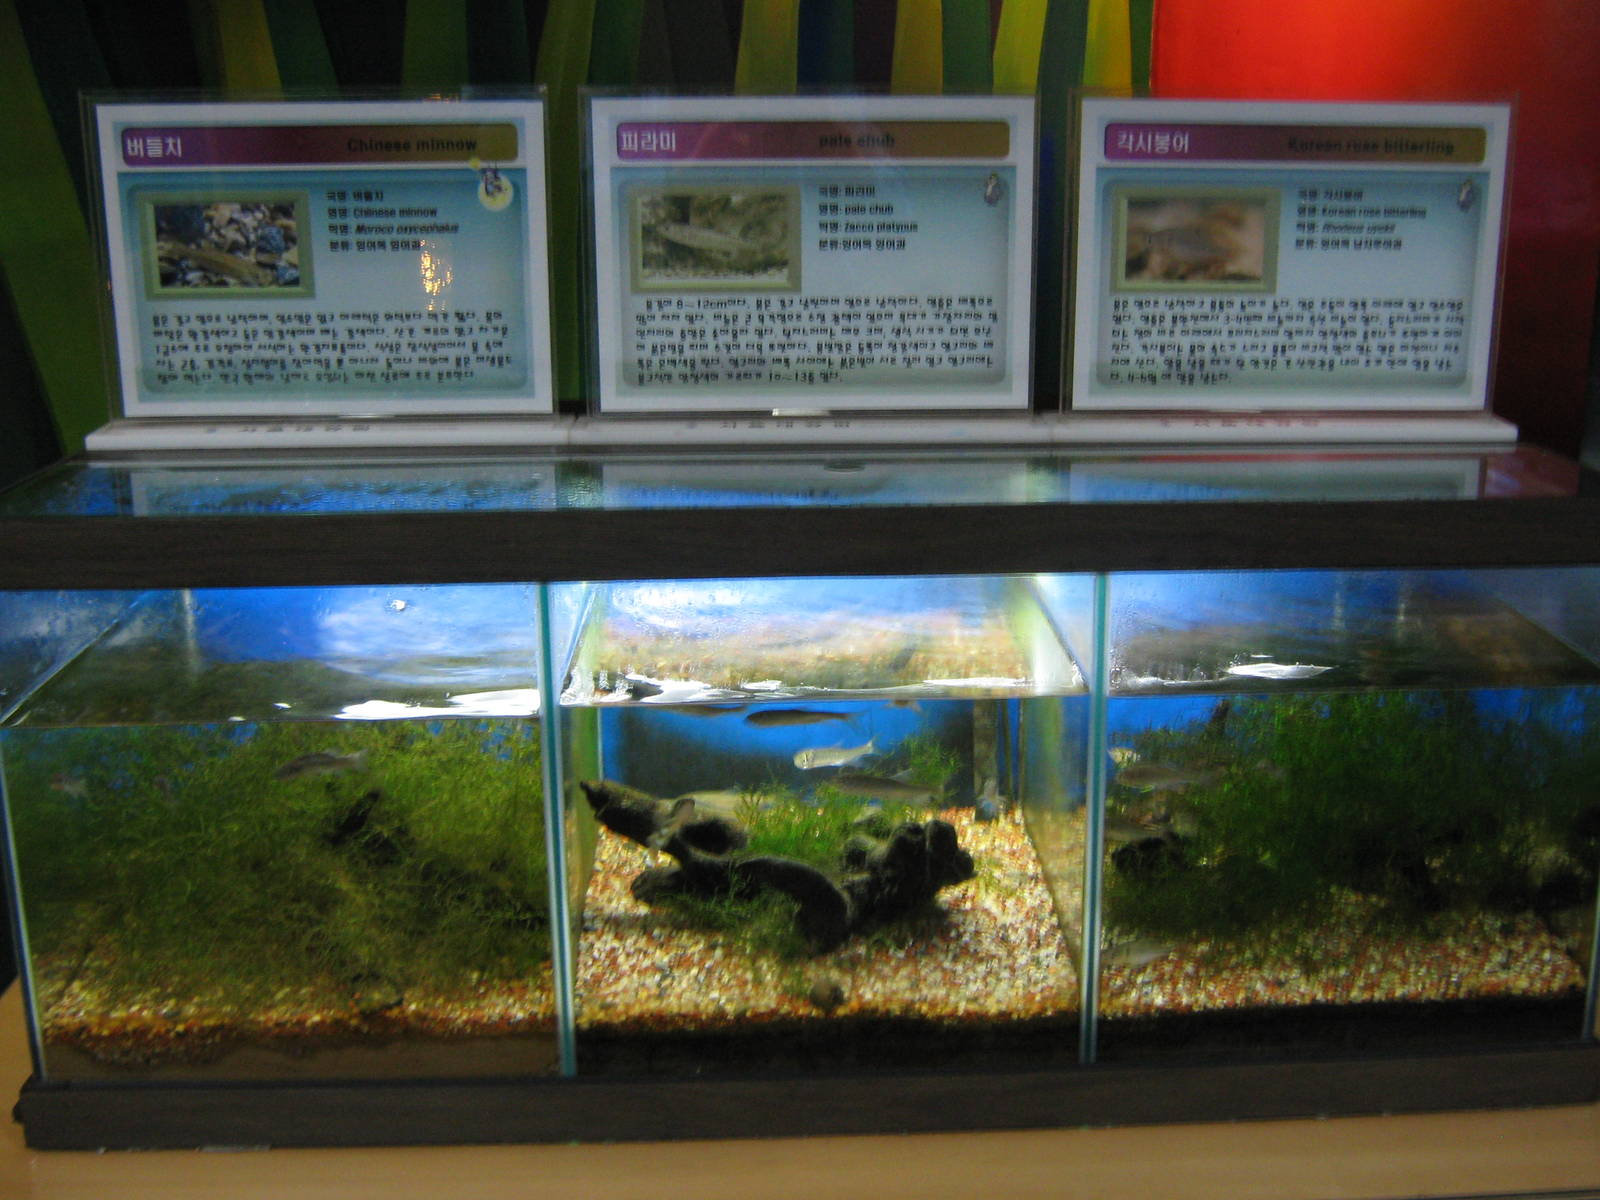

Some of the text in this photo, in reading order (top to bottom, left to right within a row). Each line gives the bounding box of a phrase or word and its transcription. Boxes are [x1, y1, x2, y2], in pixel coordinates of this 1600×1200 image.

[127, 136, 182, 158] 버들치
[347, 137, 477, 152] Chinese minnow
[623, 130, 676, 152] 피라미
[819, 133, 896, 149] pale chub
[1117, 131, 1189, 153] 각시붕어
